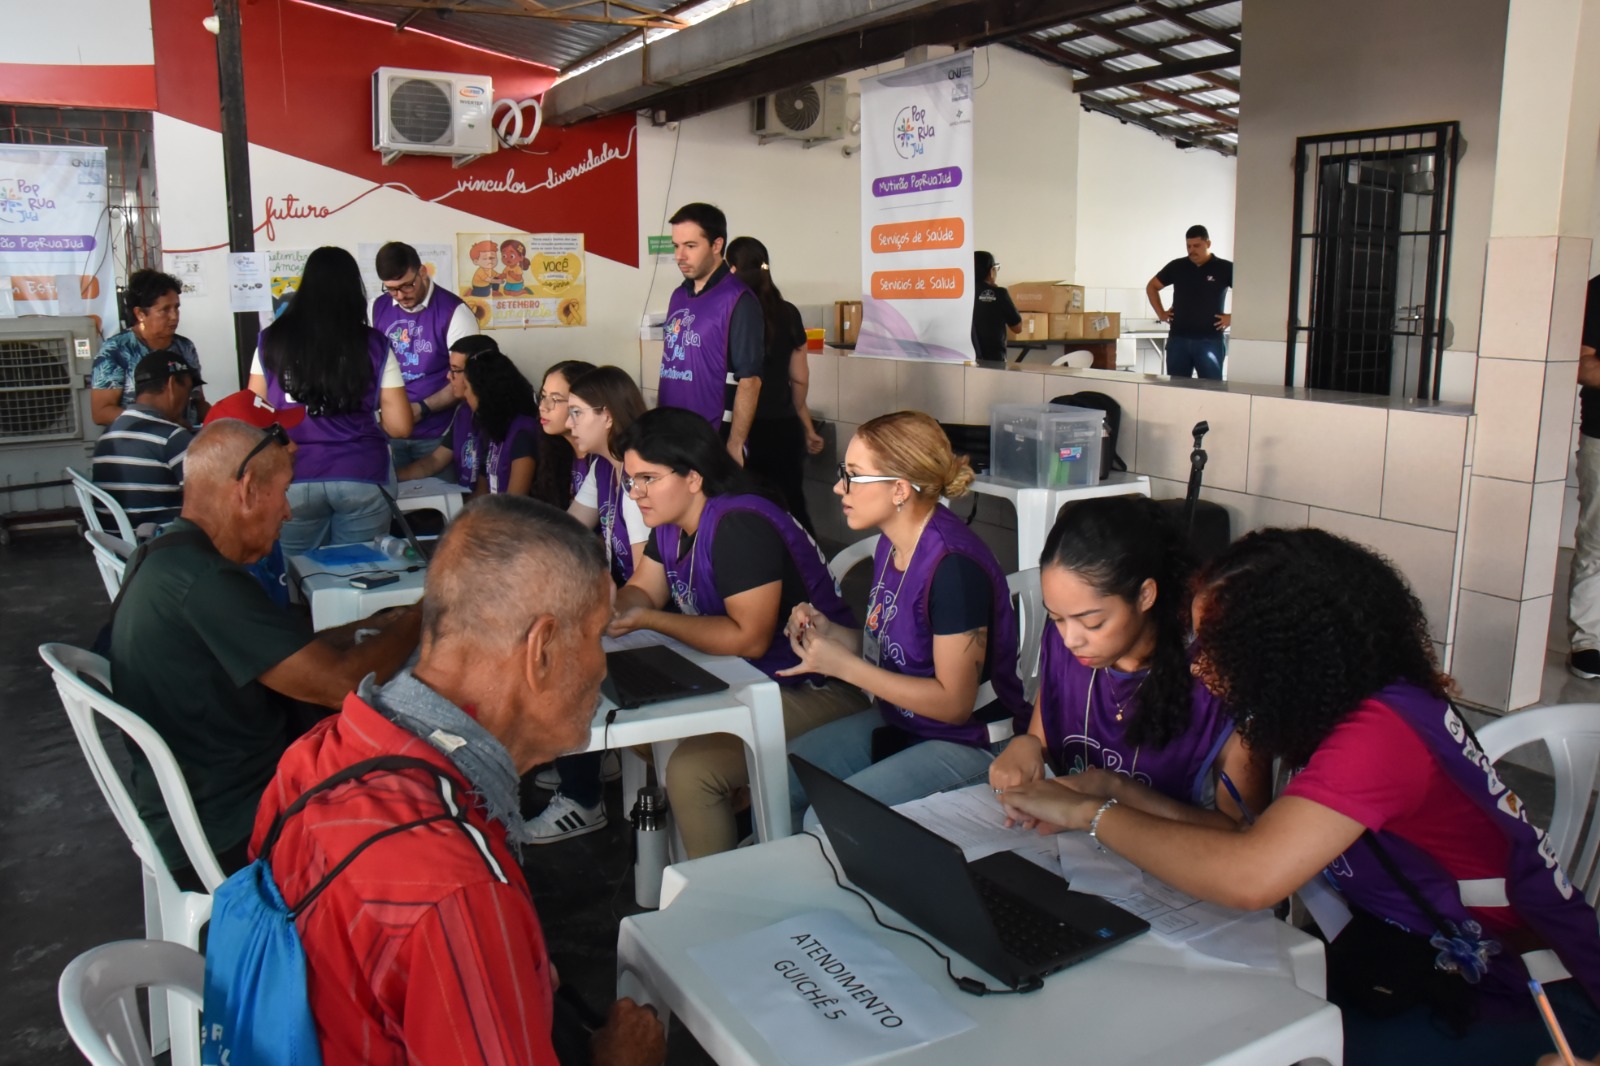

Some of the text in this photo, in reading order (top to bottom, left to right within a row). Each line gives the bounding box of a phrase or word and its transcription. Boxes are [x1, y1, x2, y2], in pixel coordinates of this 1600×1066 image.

[911, 105, 926, 124] Pop
[910, 142, 924, 158] Jud
[545, 142, 622, 189] diversidades
[17, 179, 40, 196] Pop
[879, 177, 908, 192] Mutirão
[16, 210, 39, 223] Jud
[265, 193, 332, 241] futuro
[878, 227, 955, 249] Serviços de Saúde
[880, 275, 955, 290] Servicios de Salud
[496, 300, 540, 309] SETEMBRO
[774, 959, 847, 1020] GUICHÊ 5
[790, 933, 904, 1028] ATENDIMENTO
